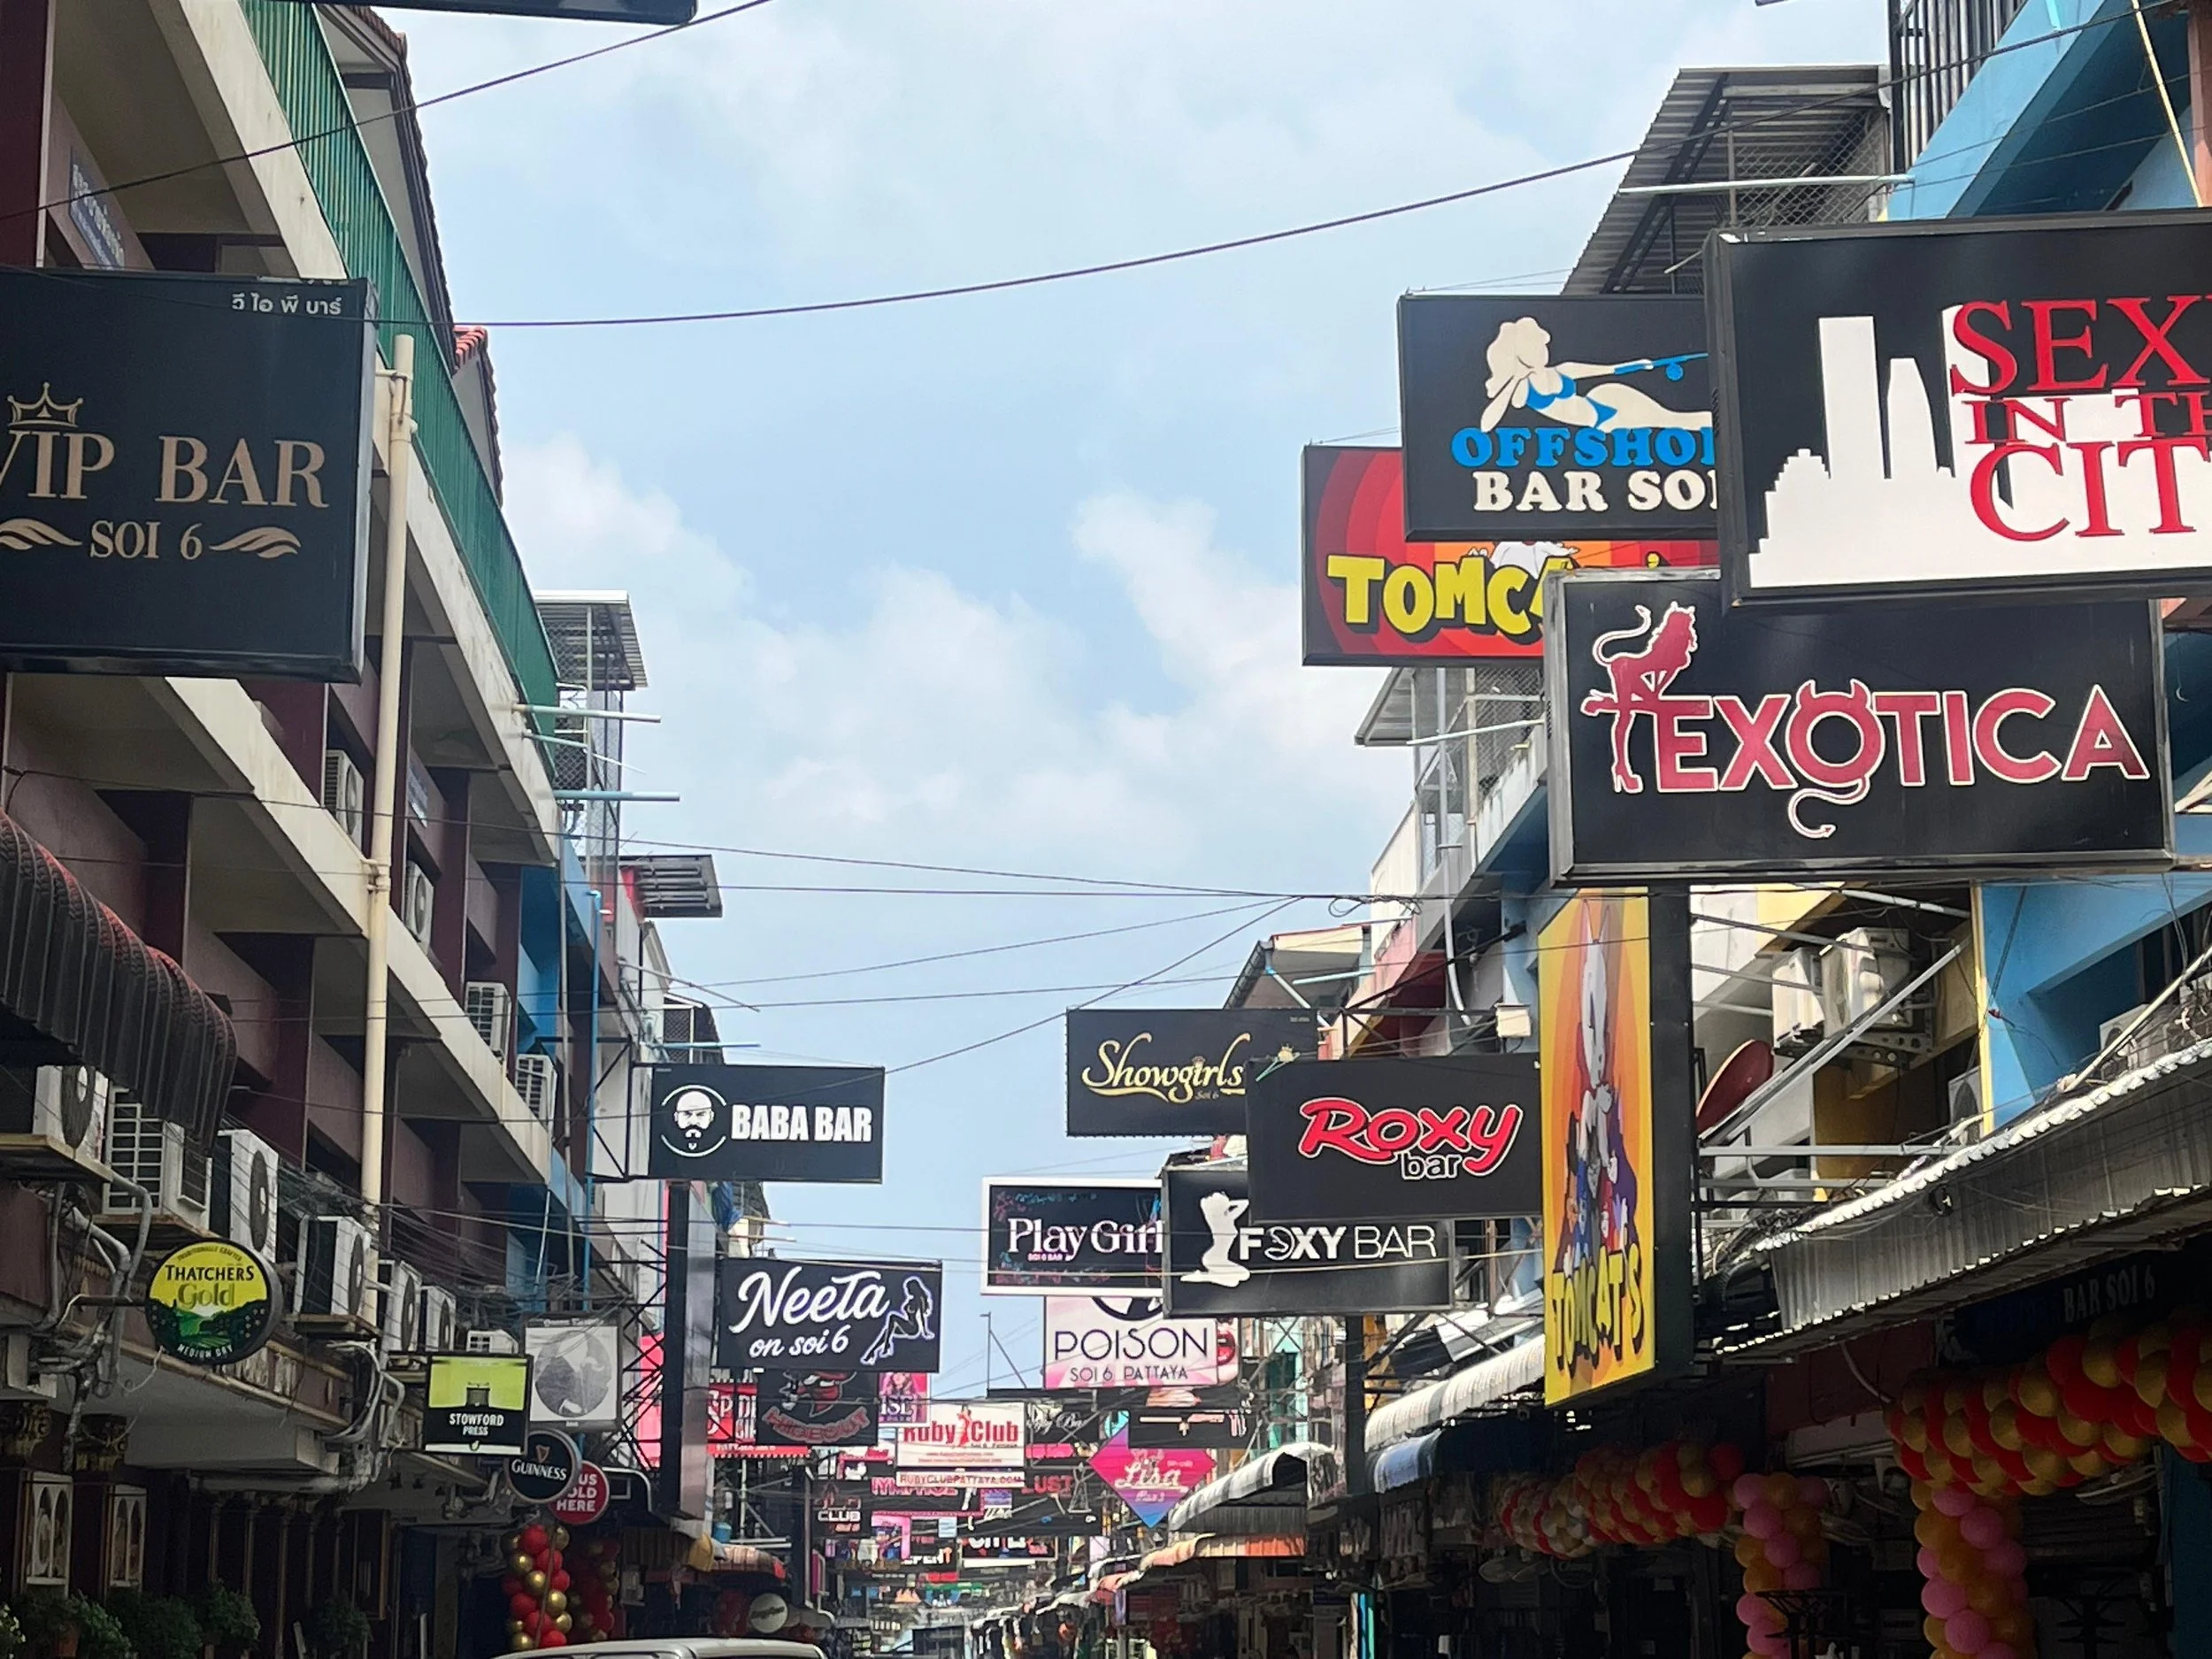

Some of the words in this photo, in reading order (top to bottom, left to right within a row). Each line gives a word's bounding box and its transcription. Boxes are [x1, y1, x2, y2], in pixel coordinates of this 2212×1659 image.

[1950, 295, 2212, 396] SEX
[1962, 397, 2072, 444] IN
[155, 434, 328, 509] BAR
[1472, 470, 1609, 511] BAR
[89, 520, 160, 559] SOI
[180, 523, 202, 560] 6
[1650, 680, 2152, 837] EXOTICA
[1081, 1032, 1251, 1104] Showgirls
[731, 1104, 809, 1141] BABA
[814, 1106, 872, 1142] BAR
[1298, 1096, 1524, 1176] Roxy
[1401, 1150, 1463, 1180] bar
[1008, 1217, 1088, 1262] Play
[1240, 1225, 1347, 1261] FOXY
[1355, 1225, 1437, 1259] BAR
[165, 1264, 255, 1281] THATCHERS
[178, 1283, 235, 1310] Gold
[2063, 1277, 2101, 1323] BAR
[2106, 1264, 2138, 1311] SOI
[2144, 1263, 2156, 1300] 6
[177, 1343, 211, 1358] MEDIUM
[216, 1344, 234, 1357] DRY
[749, 1337, 784, 1357] on
[788, 1329, 827, 1356] soi
[831, 1325, 852, 1354] 6
[1055, 1327, 1207, 1360] POISON
[1070, 1367, 1098, 1382] SOI
[1102, 1367, 1113, 1382] 6
[1124, 1365, 1188, 1381] PATTAYA
[449, 1413, 504, 1426] STOWFORD
[463, 1426, 488, 1436] PRESS
[902, 1420, 956, 1444] Ruby
[972, 1420, 1019, 1442] Club
[511, 1458, 566, 1480] GUINNESS
[556, 1499, 596, 1512] HERE
[567, 1486, 597, 1499] OLD
